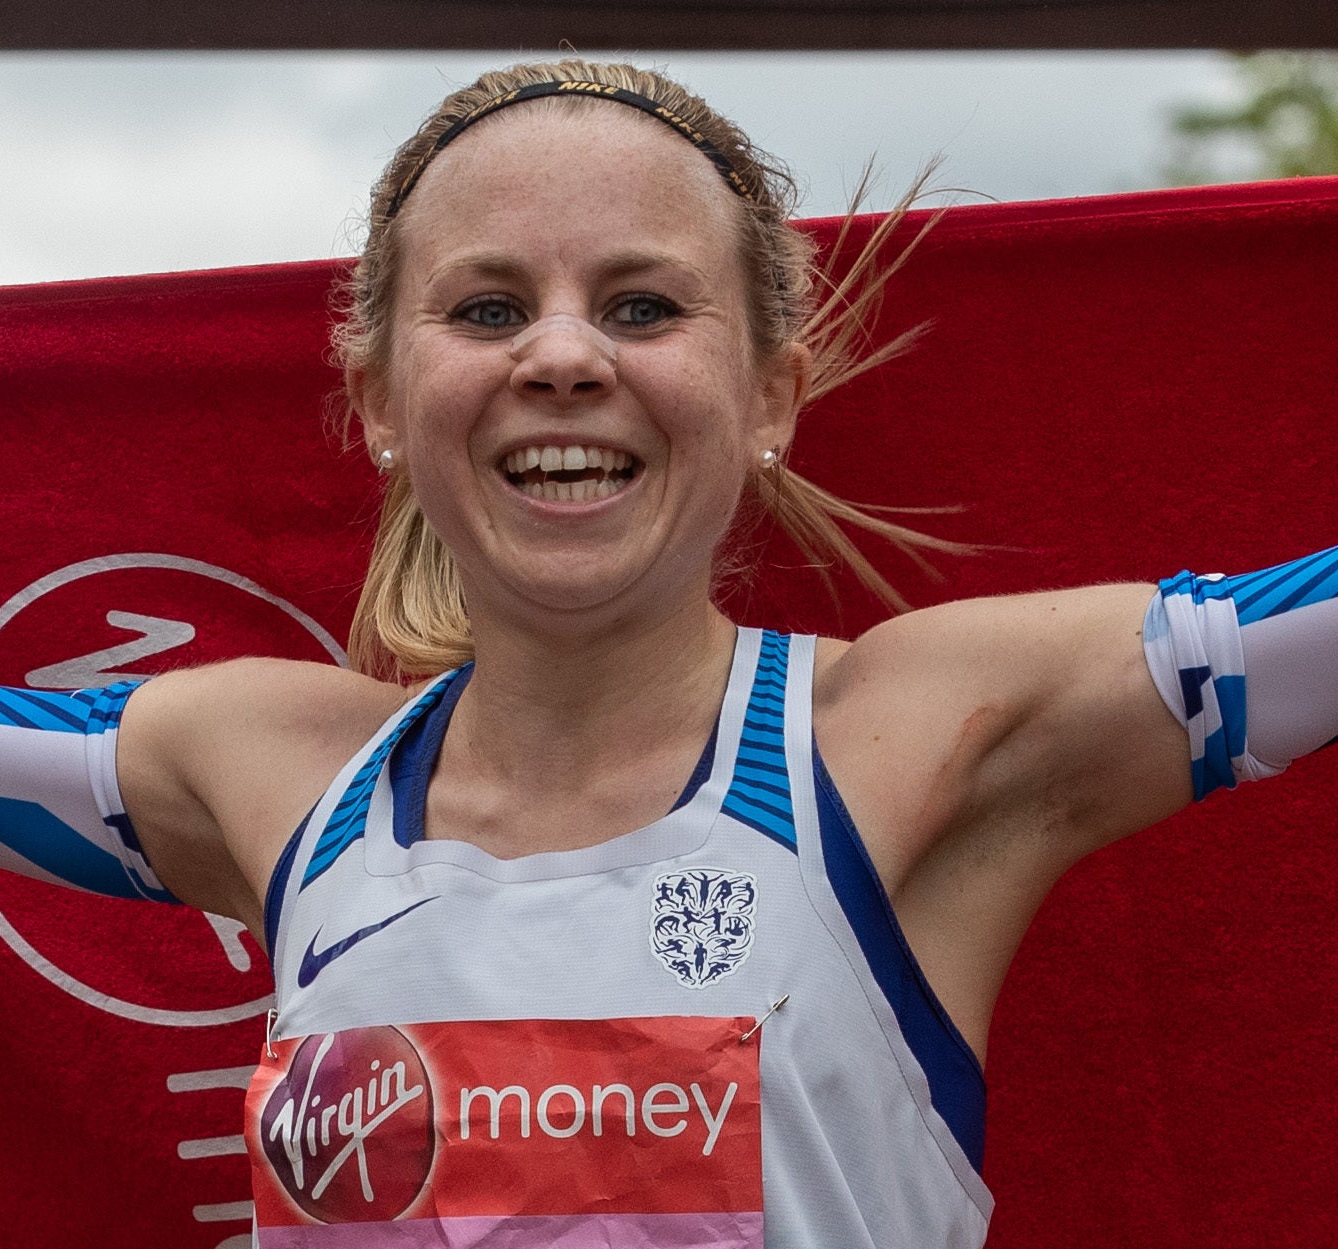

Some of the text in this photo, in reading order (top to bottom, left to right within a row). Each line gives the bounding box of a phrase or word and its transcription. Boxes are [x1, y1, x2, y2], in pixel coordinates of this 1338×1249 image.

[558, 80, 619, 95] NIKE
[655, 106, 705, 142] NIKE
[269, 1032, 739, 1203] Virgin money
